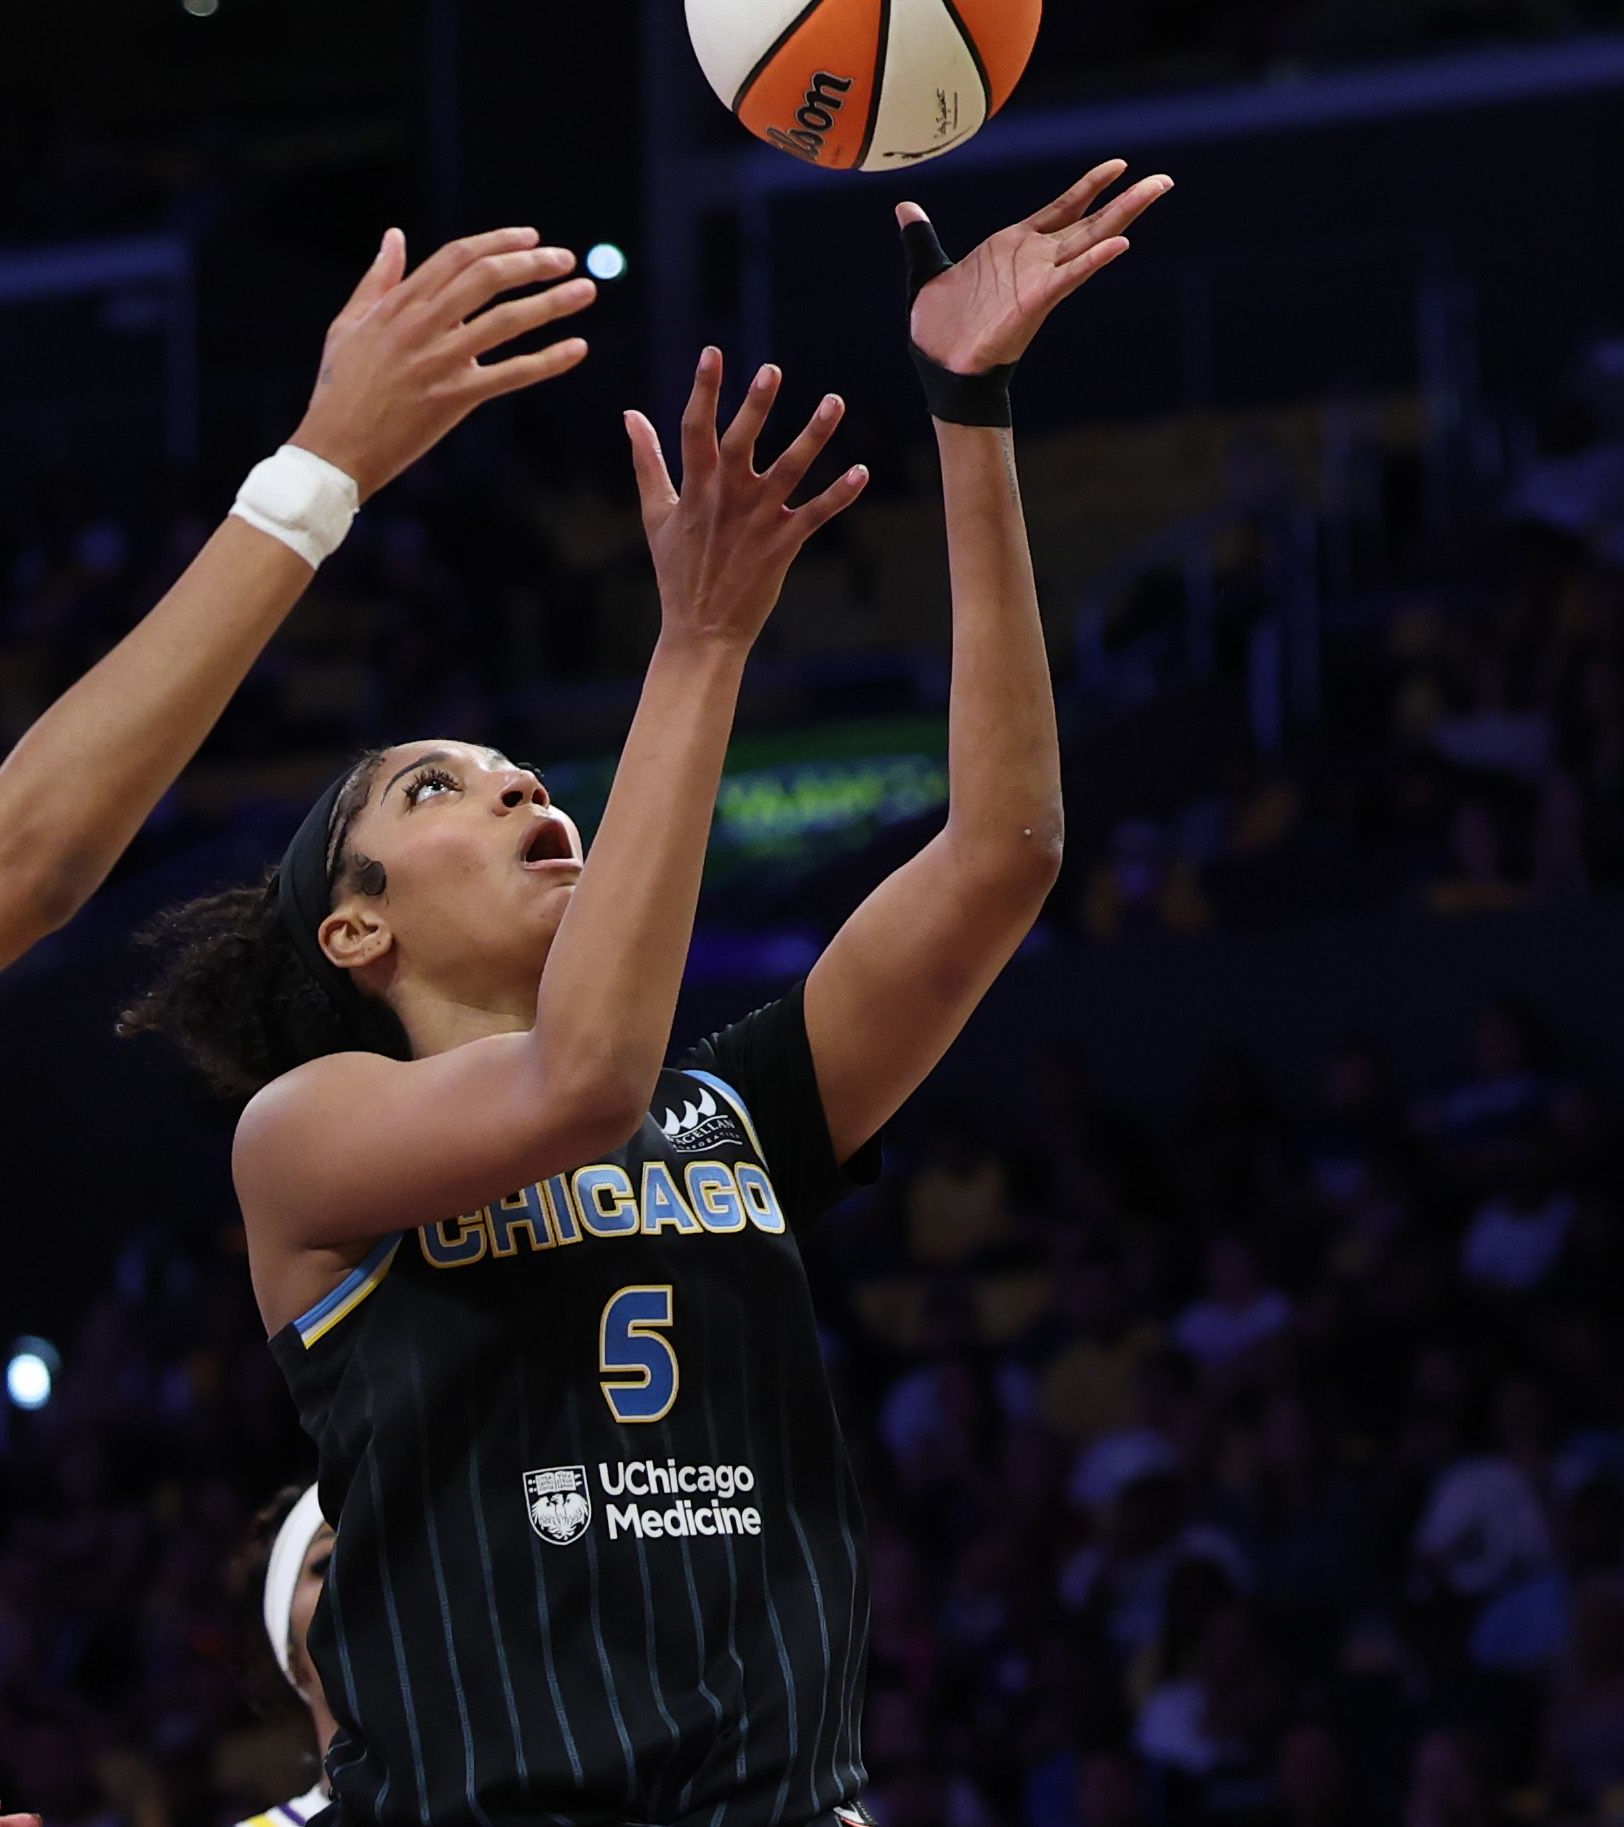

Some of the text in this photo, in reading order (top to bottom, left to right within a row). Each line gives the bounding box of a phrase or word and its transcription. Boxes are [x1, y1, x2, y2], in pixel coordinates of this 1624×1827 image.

[418, 1161, 785, 1268] CHICAGO
[598, 1284, 679, 1424] 5
[598, 1458, 755, 1500] UChicago
[606, 1500, 762, 1541] Medicine
